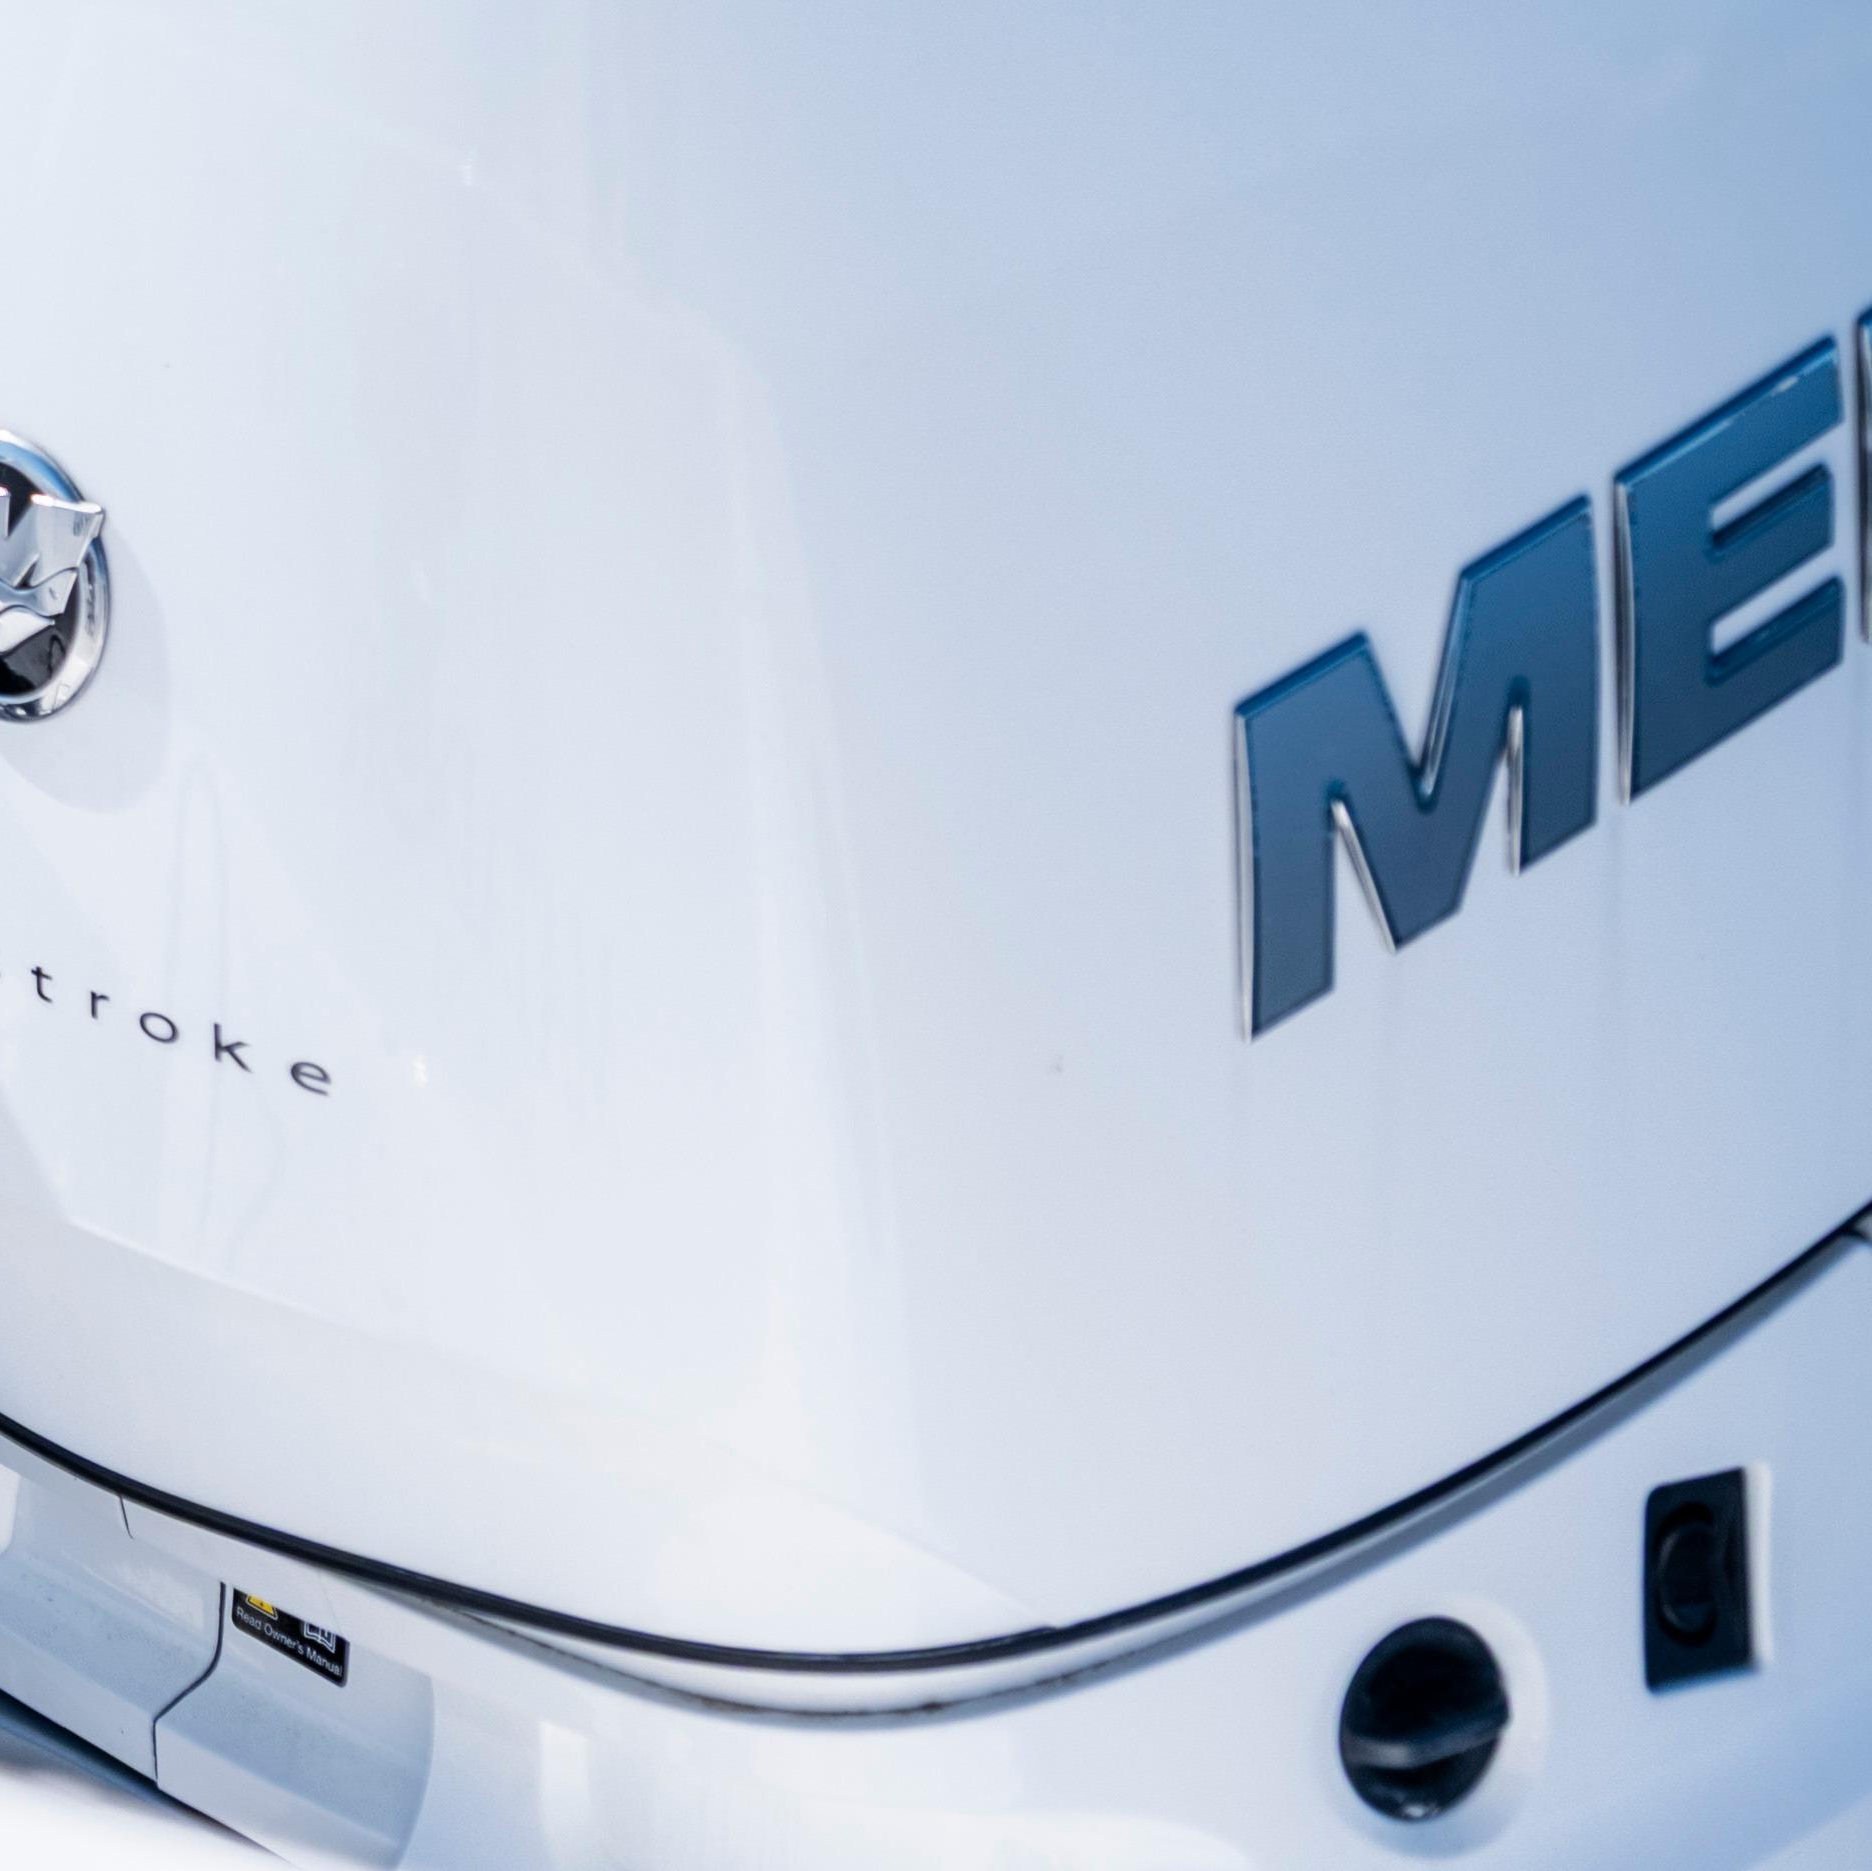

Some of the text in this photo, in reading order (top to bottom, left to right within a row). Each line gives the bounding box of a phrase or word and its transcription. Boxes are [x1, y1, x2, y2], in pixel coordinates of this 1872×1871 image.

[1233, 302, 1872, 1044] ME
[237, 1607, 343, 1676] Read Owner's Manual
